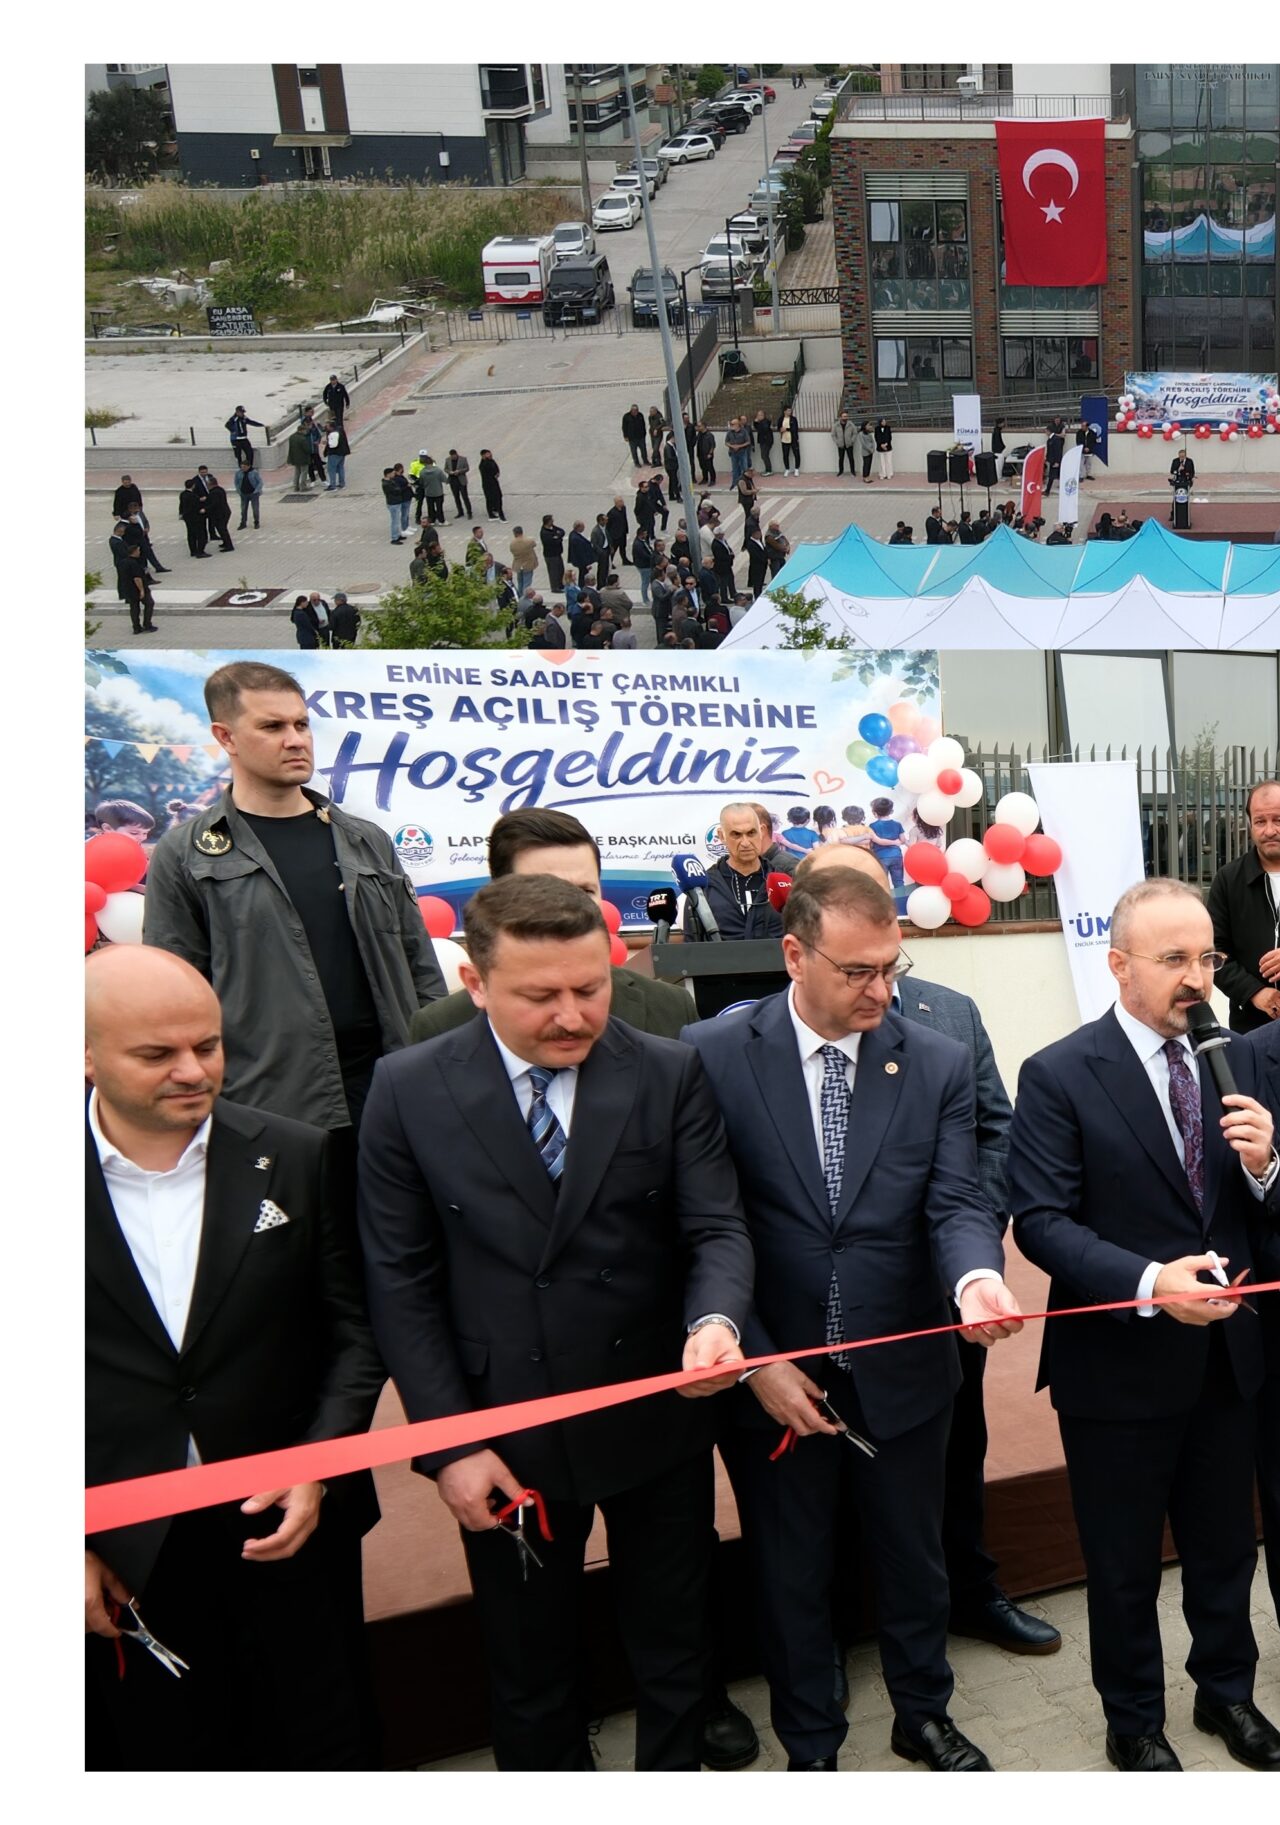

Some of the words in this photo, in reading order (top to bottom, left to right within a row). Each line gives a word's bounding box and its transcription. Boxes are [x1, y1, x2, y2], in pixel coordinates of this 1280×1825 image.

[1162, 393, 1248, 409] Hoşgeldiniz
[386, 662, 482, 685] EMİNE
[490, 669, 603, 690] SAADET
[612, 673, 740, 695] ÇARMIKLI
[305, 690, 434, 729] KREŞ
[450, 695, 600, 733] AÇILIŞ
[611, 695, 818, 729] TÖRENİNE
[318, 730, 806, 815] Hoşgeldiniz
[448, 836, 492, 847] LAPS
[608, 834, 696, 848] BAŞKANLIĞI
[650, 893, 668, 902] TRT
[623, 911, 649, 921] GELİŞ
